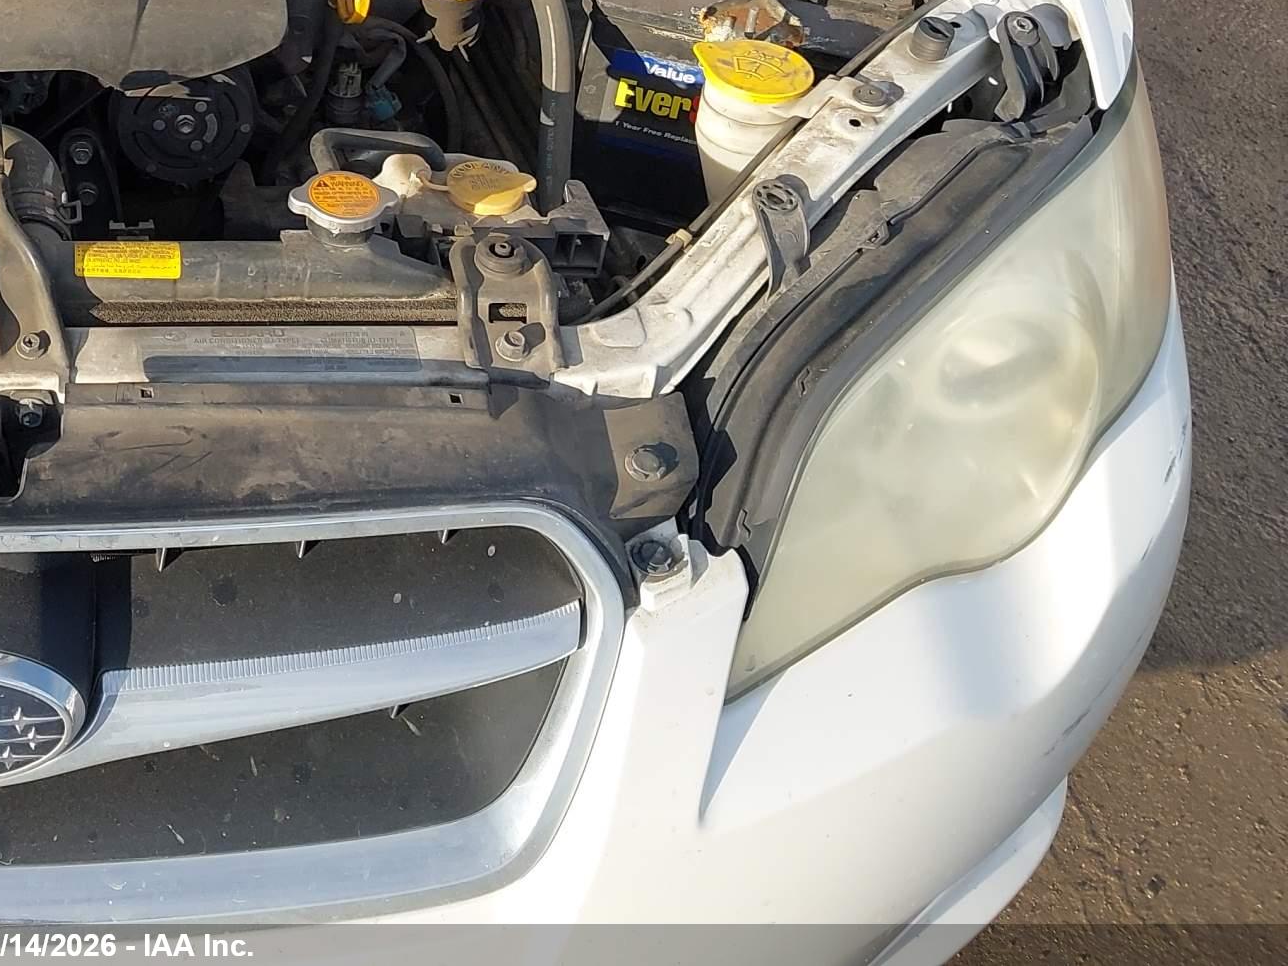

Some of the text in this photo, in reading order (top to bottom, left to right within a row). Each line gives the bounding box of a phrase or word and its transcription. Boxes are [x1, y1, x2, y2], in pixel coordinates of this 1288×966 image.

[643, 60, 697, 85] Value
[623, 121, 643, 132] Year
[643, 126, 663, 137] Free
